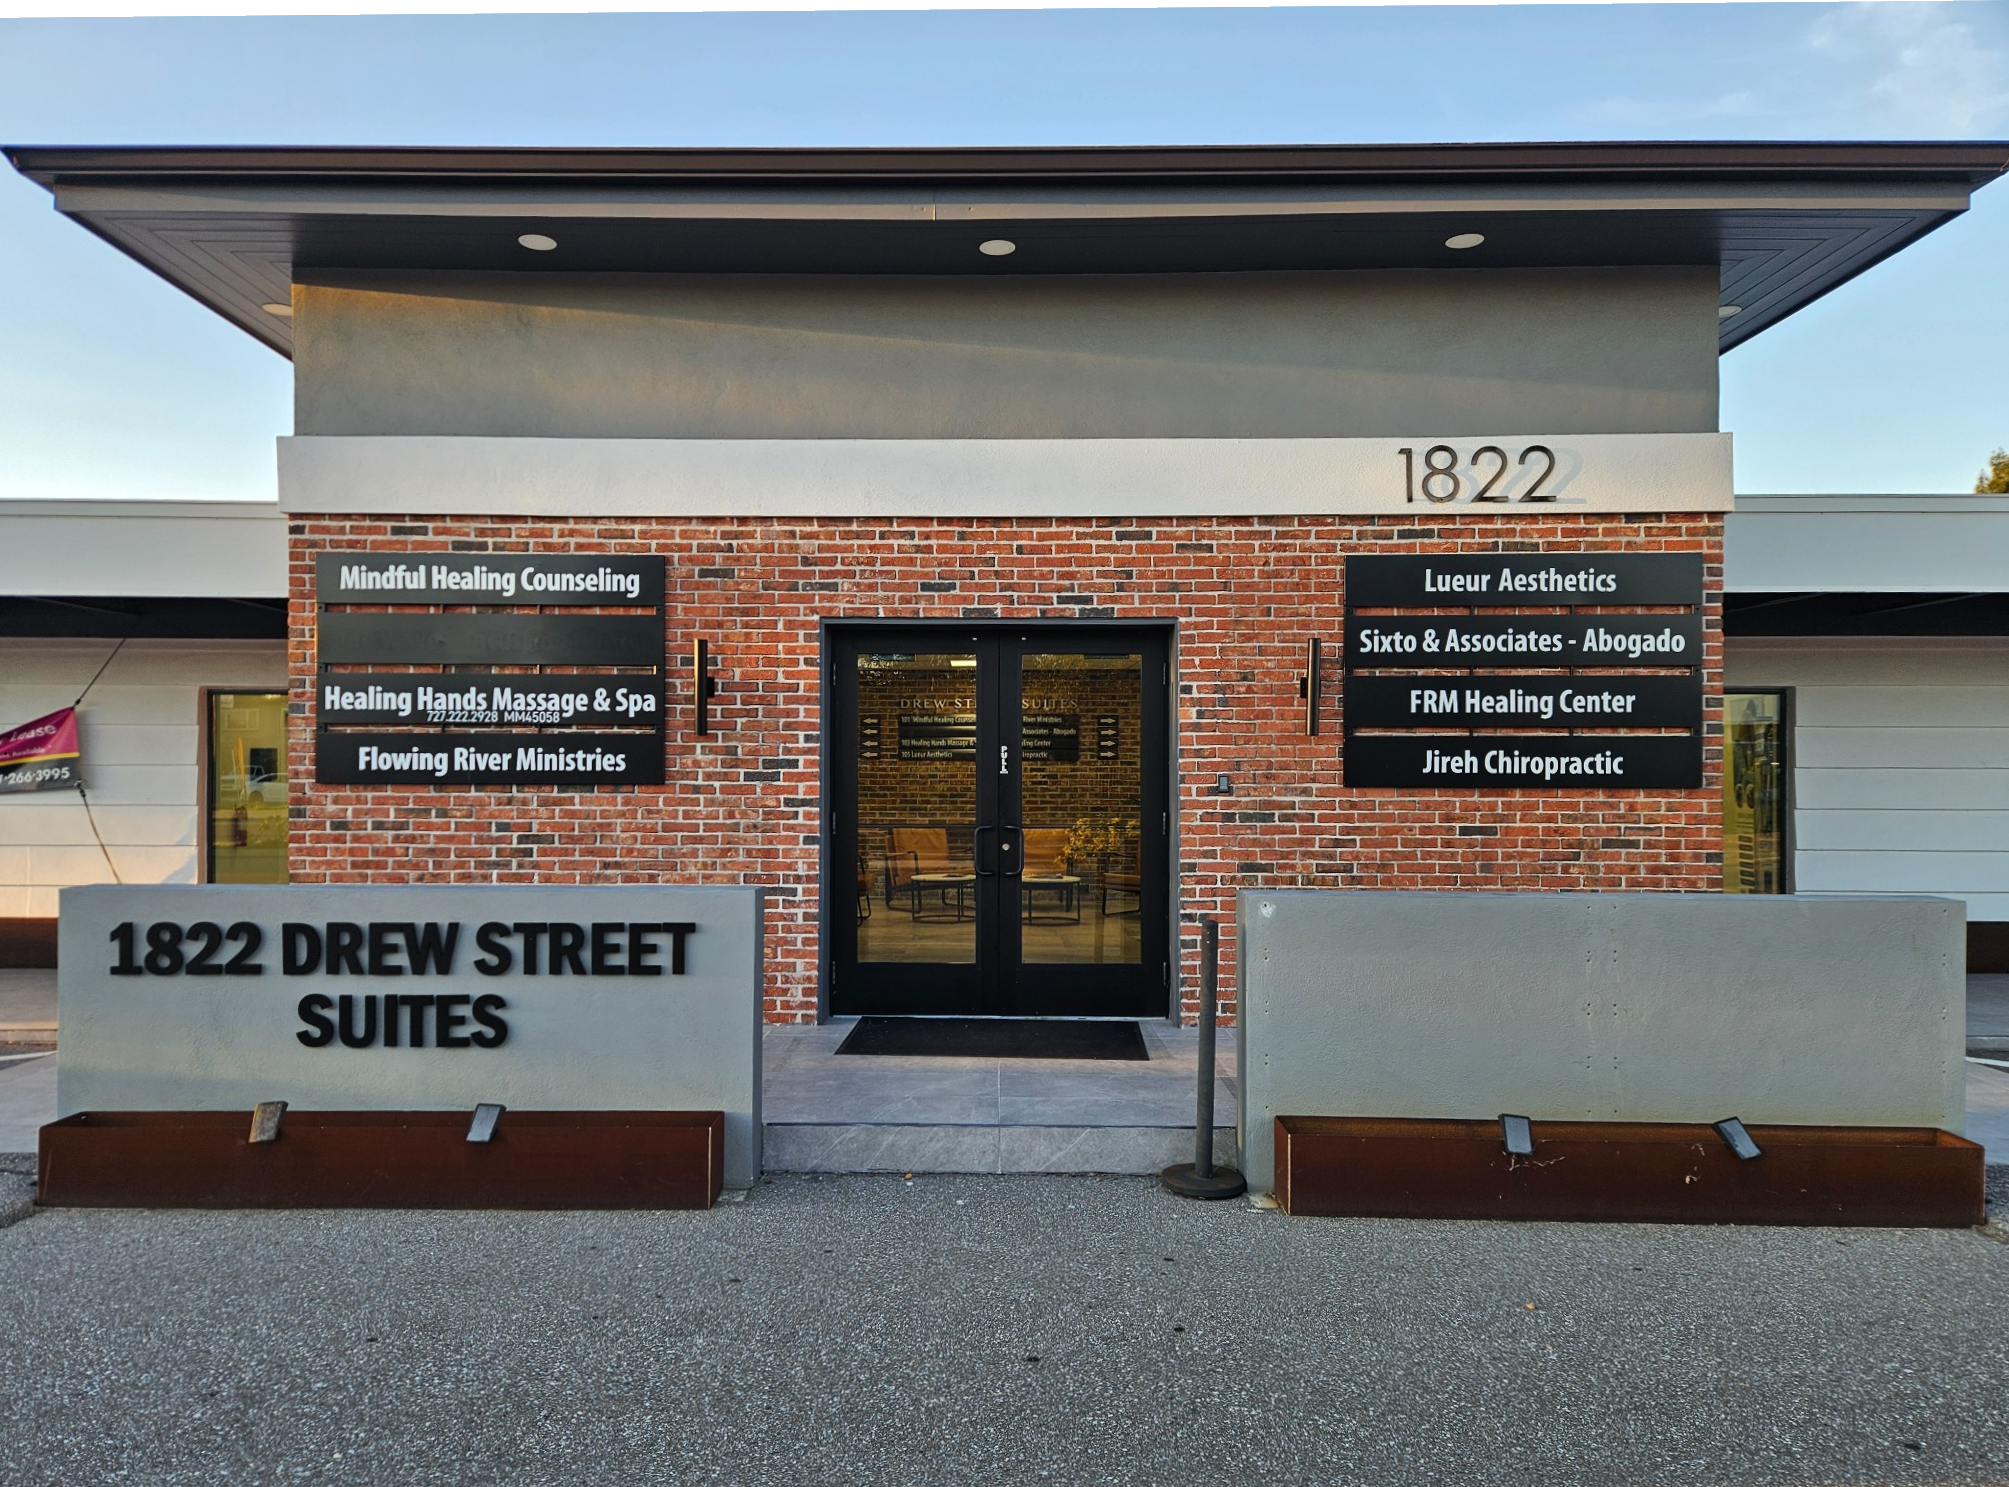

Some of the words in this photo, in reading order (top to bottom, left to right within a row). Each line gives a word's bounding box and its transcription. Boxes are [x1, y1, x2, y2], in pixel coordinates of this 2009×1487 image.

[1398, 445, 1557, 503] 1822
[340, 565, 425, 590] Mindful
[431, 566, 516, 597] Healing
[521, 567, 640, 598] Counseling
[1425, 568, 1490, 592] Lueur
[1498, 567, 1617, 593] Aesthetics
[1360, 629, 1417, 653] Sixto
[1422, 629, 1440, 653] &
[1445, 628, 1563, 653] Associates
[1583, 628, 1686, 658] Abogado
[325, 686, 412, 716] Healing
[417, 687, 487, 712] Hands
[492, 687, 588, 718] Massage
[593, 689, 611, 711] &
[615, 688, 656, 718] Spa
[426, 710, 499, 723] 727.222.2928
[504, 712, 560, 724] MM45058
[901, 699, 946, 709] DREW
[1022, 699, 1078, 709] SUITES
[1410, 690, 1458, 713] FRM
[1465, 689, 1554, 719] Healing
[1559, 689, 1636, 714] Center
[934, 716, 954, 724] Healing
[358, 747, 448, 777] Flowing
[454, 748, 512, 772] River
[516, 748, 626, 772] Ministries
[1423, 750, 1478, 775] Jireh
[1484, 750, 1624, 780] Chiropractic
[109, 921, 263, 976] 1822
[281, 922, 460, 976] DREW
[473, 921, 696, 976] STREET
[295, 993, 509, 1049] SUITES
